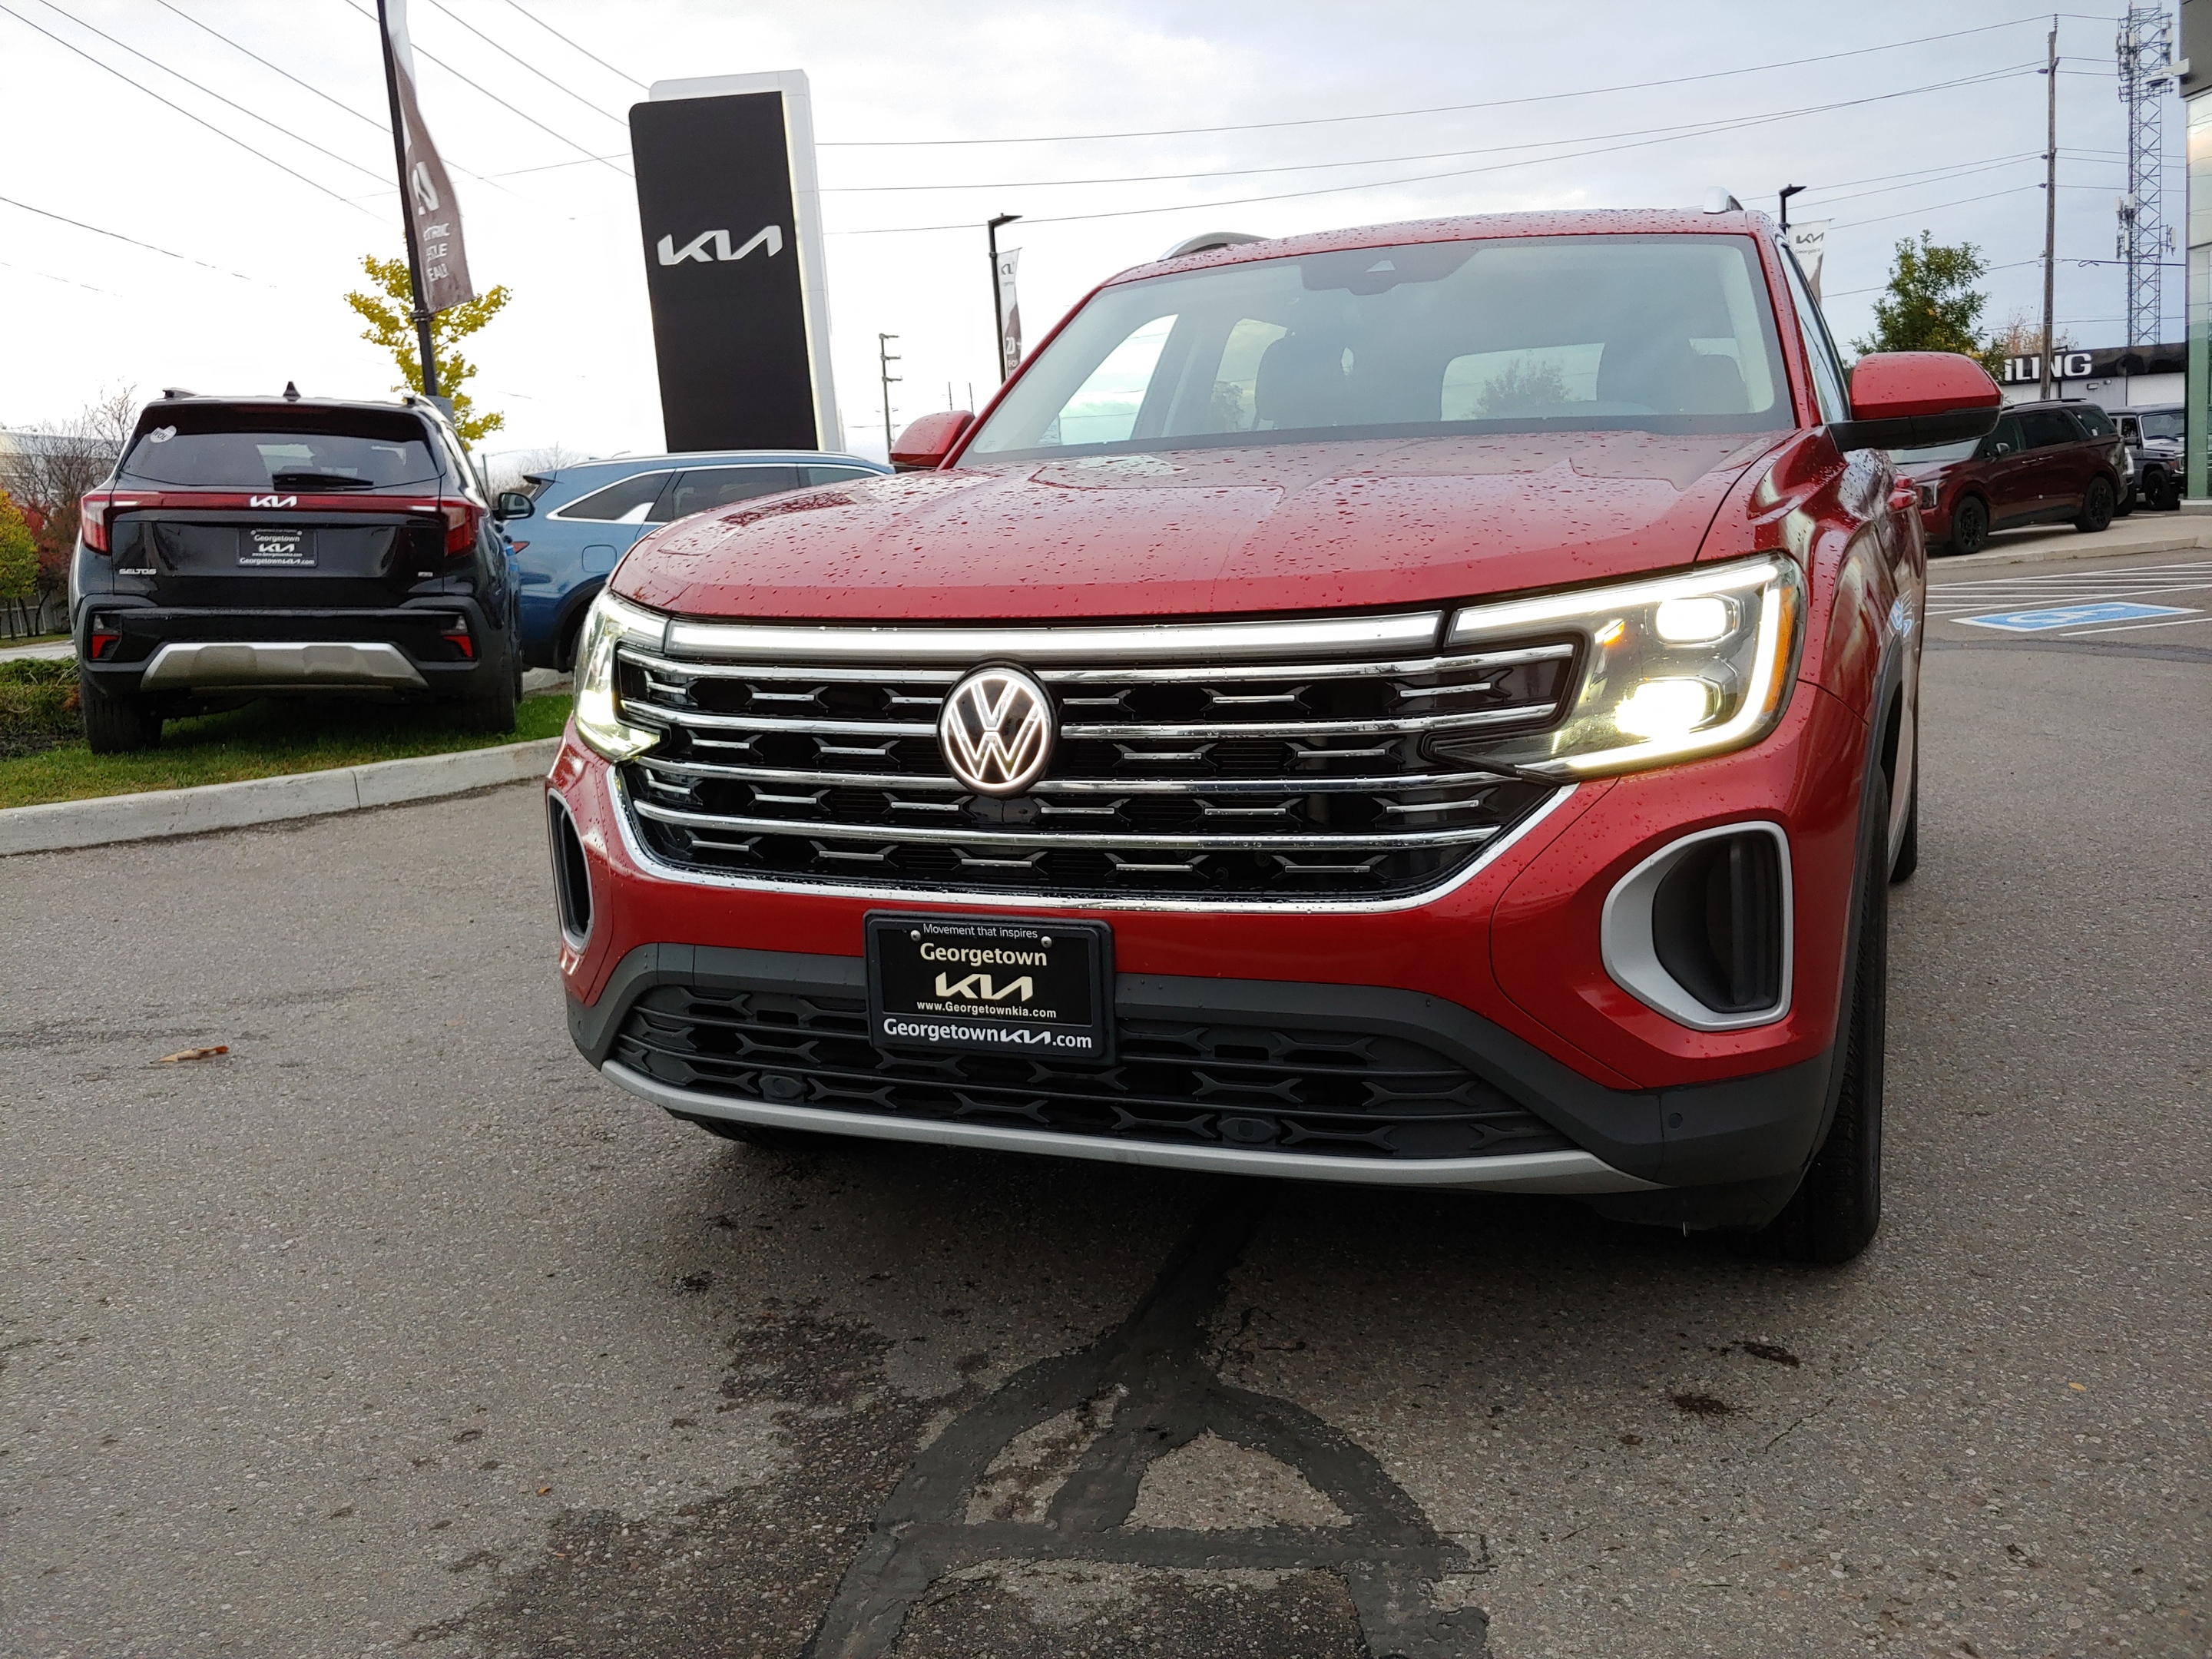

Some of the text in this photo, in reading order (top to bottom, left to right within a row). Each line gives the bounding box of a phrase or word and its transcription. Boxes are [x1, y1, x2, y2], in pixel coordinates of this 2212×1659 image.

[923, 923, 1038, 939] Movement that inspires
[920, 942, 1048, 967] Georgetown
[916, 1001, 1057, 1018] www.Georgetownkia.com
